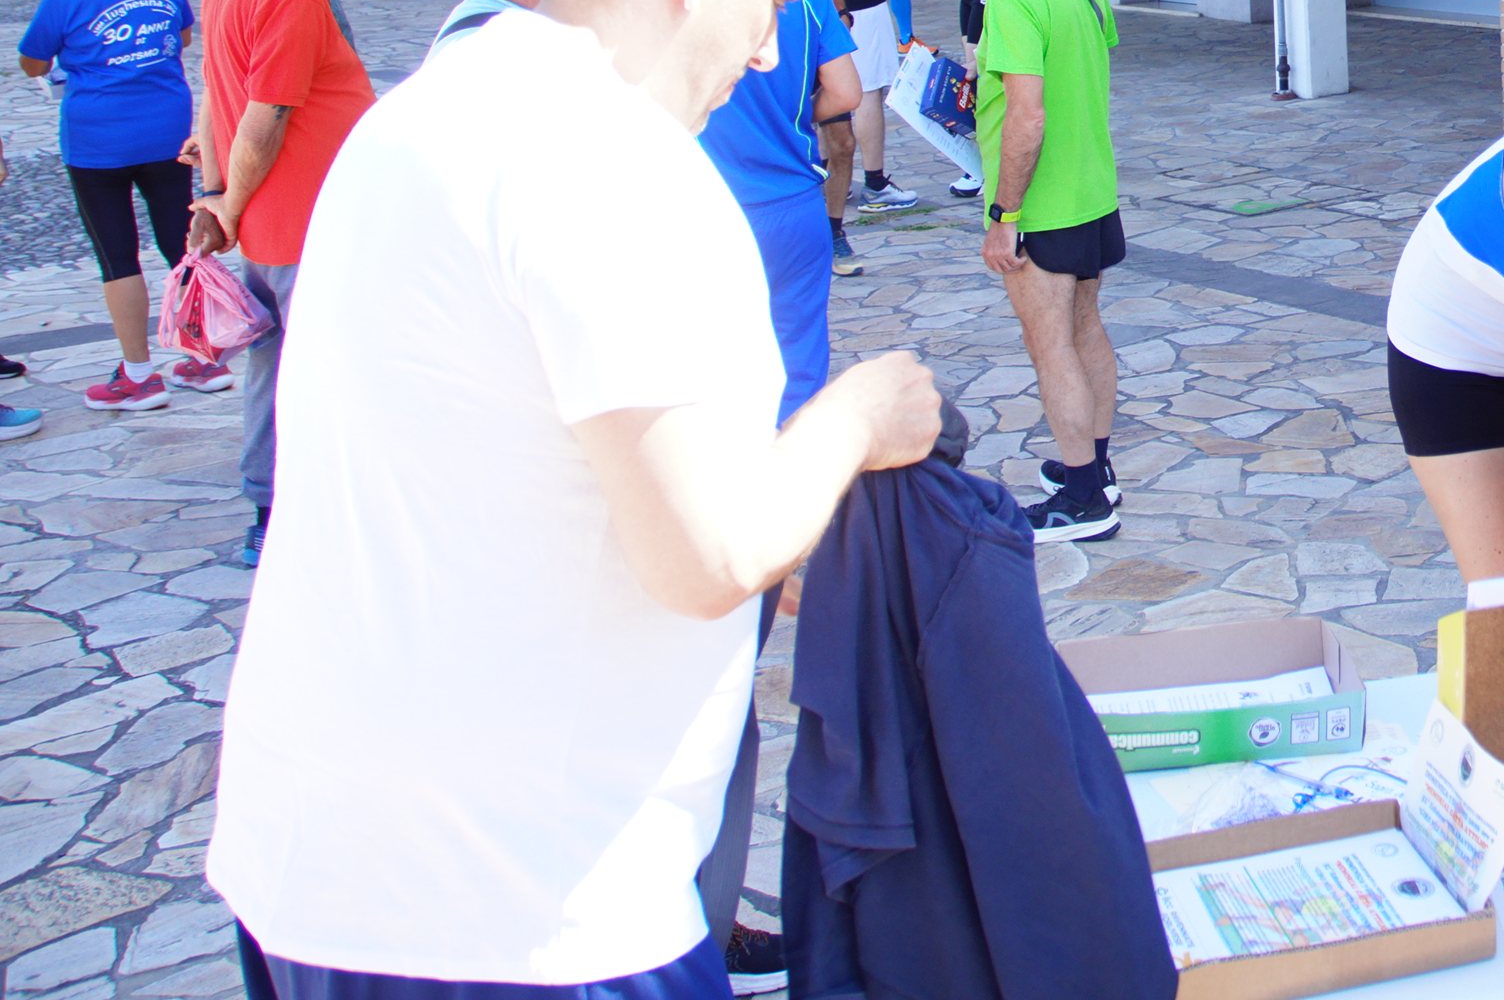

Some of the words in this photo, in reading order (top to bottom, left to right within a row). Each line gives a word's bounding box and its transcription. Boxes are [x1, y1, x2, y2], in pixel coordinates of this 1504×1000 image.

[103, 24, 132, 45] 30
[136, 20, 171, 37] ANNI
[107, 48, 160, 66] PODISMO
